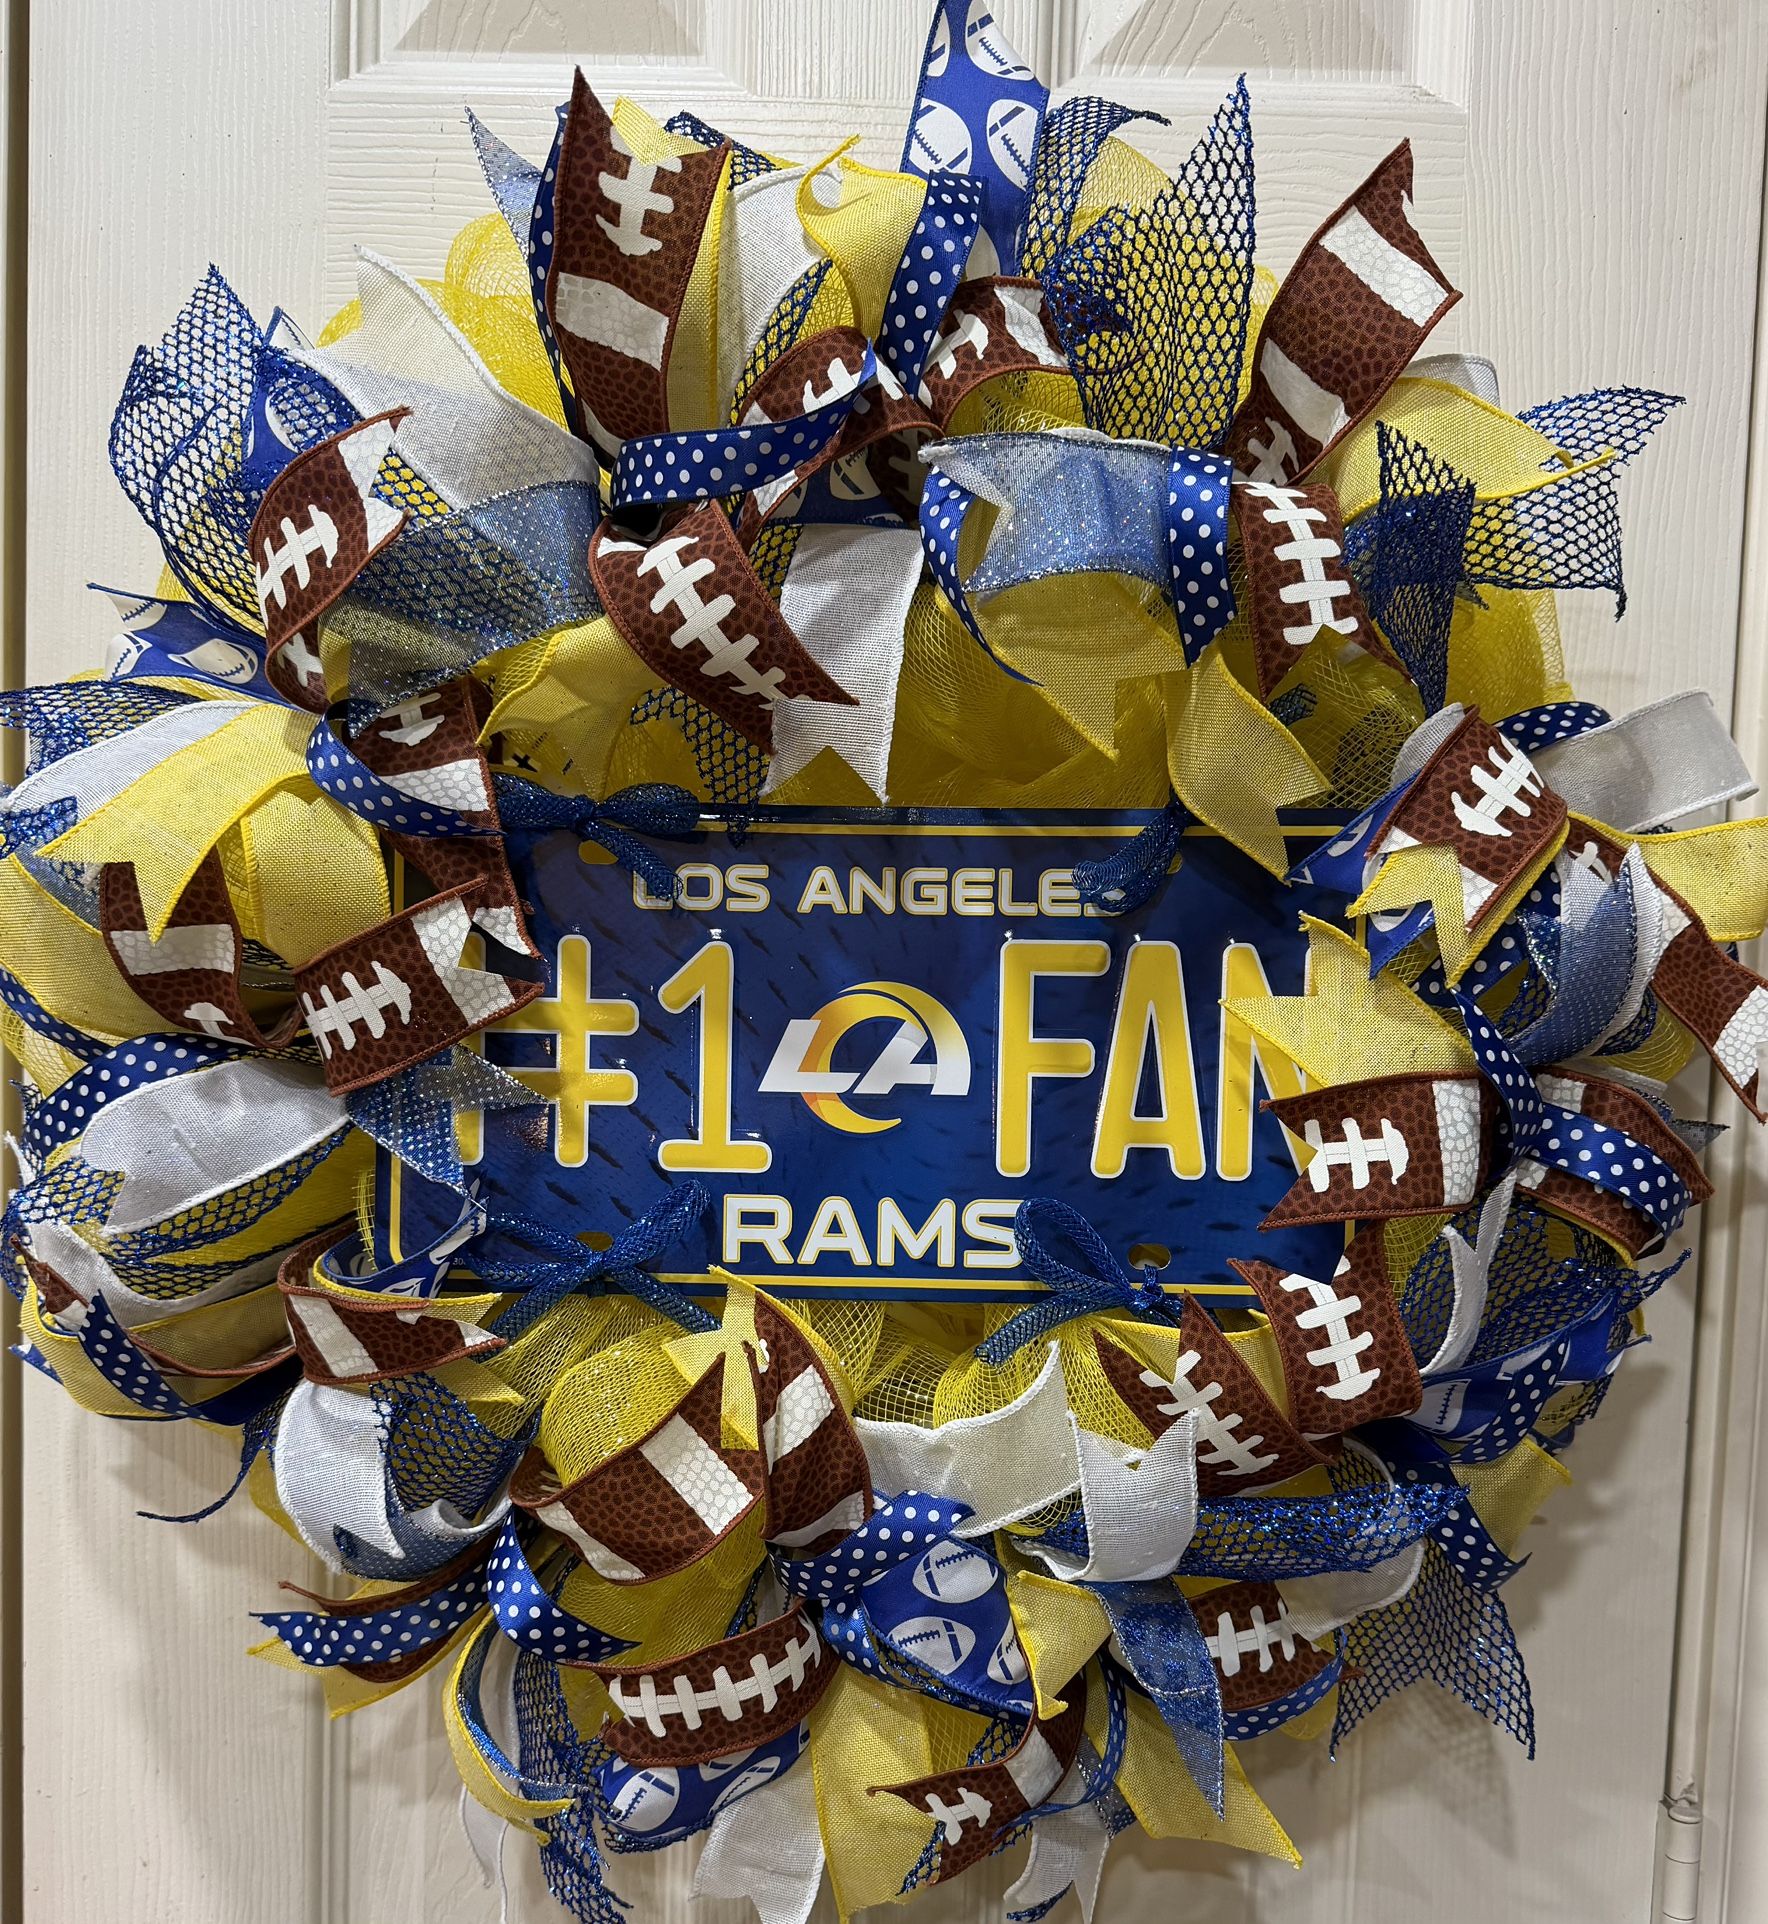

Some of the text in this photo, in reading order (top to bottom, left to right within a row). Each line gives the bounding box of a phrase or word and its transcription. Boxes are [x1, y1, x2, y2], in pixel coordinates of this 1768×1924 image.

[633, 863, 771, 912] LOS
[450, 934, 772, 1174] #1
[722, 1194, 1023, 1269] RAMS
